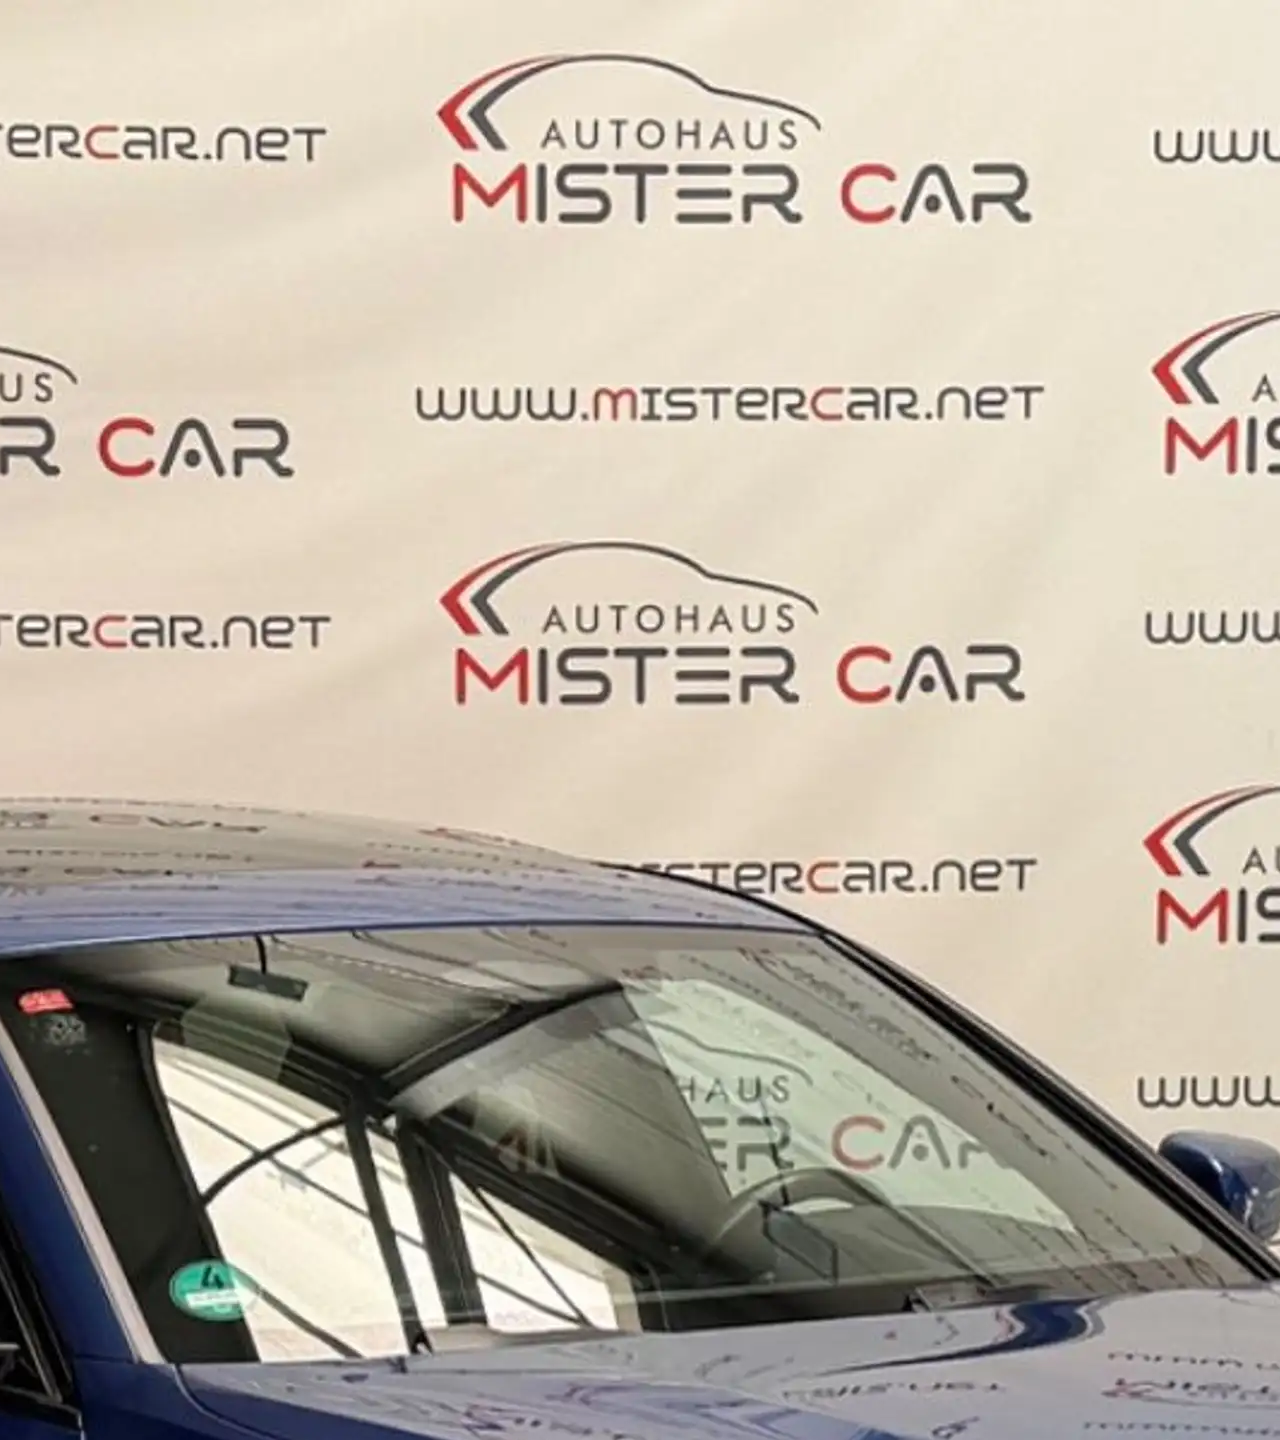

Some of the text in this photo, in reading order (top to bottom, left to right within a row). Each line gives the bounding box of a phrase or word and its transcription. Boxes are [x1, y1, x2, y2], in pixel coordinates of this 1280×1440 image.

[541, 119, 797, 150] AUTOHAUS
[453, 163, 1032, 224] MISTER CAR
[98, 418, 294, 477] CAR
[543, 604, 794, 633] AUTOHAUS
[456, 645, 1025, 705] MISTER CAR
[201, 1264, 225, 1289] 4
